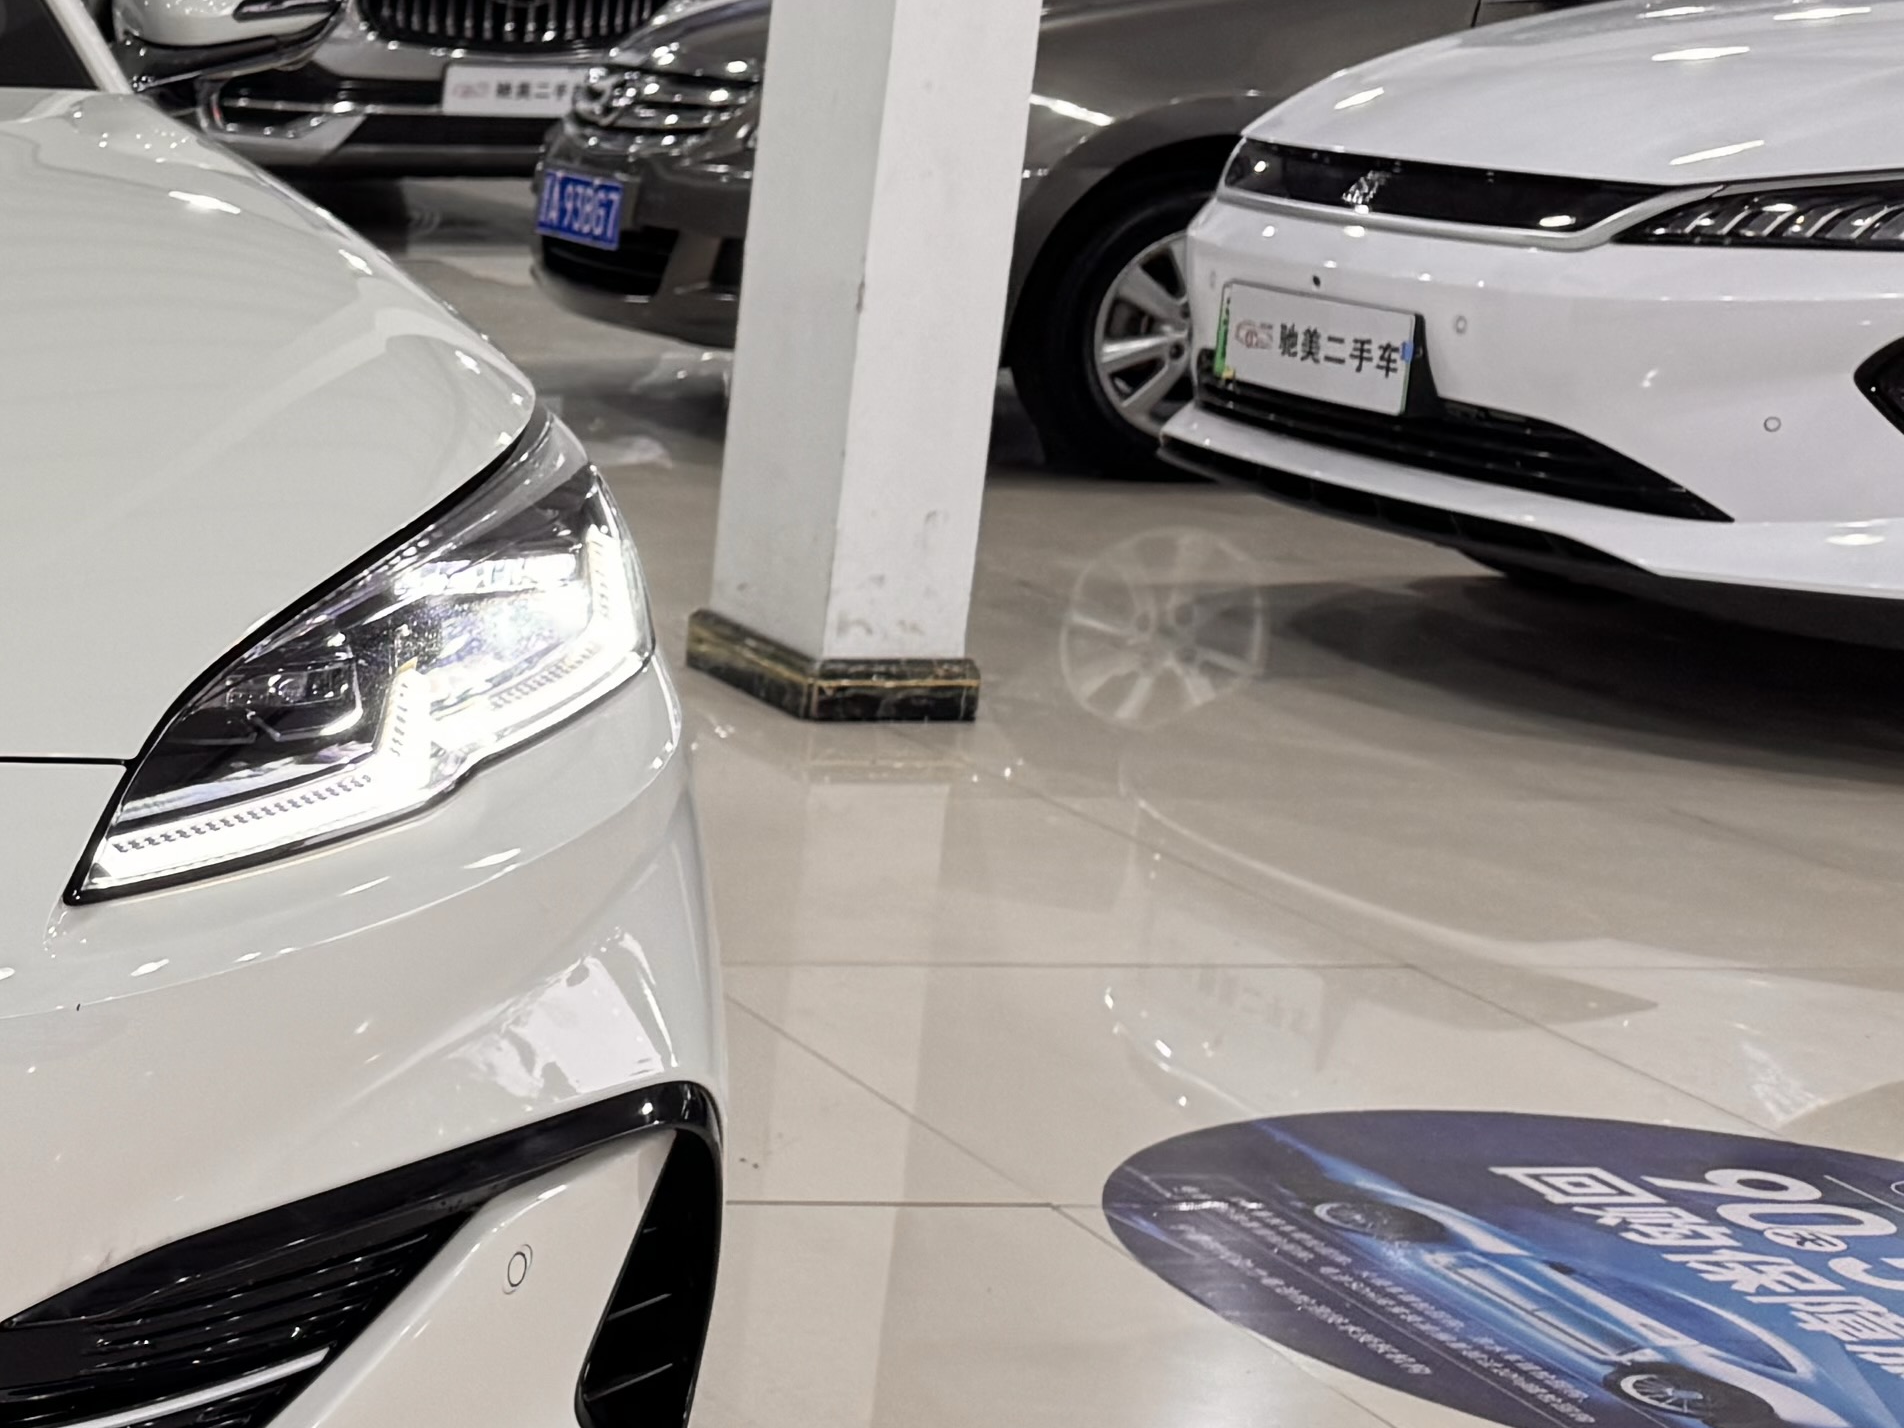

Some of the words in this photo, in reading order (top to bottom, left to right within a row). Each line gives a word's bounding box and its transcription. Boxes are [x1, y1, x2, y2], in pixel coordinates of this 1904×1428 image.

[1279, 322, 1400, 378] 驰美二手车
